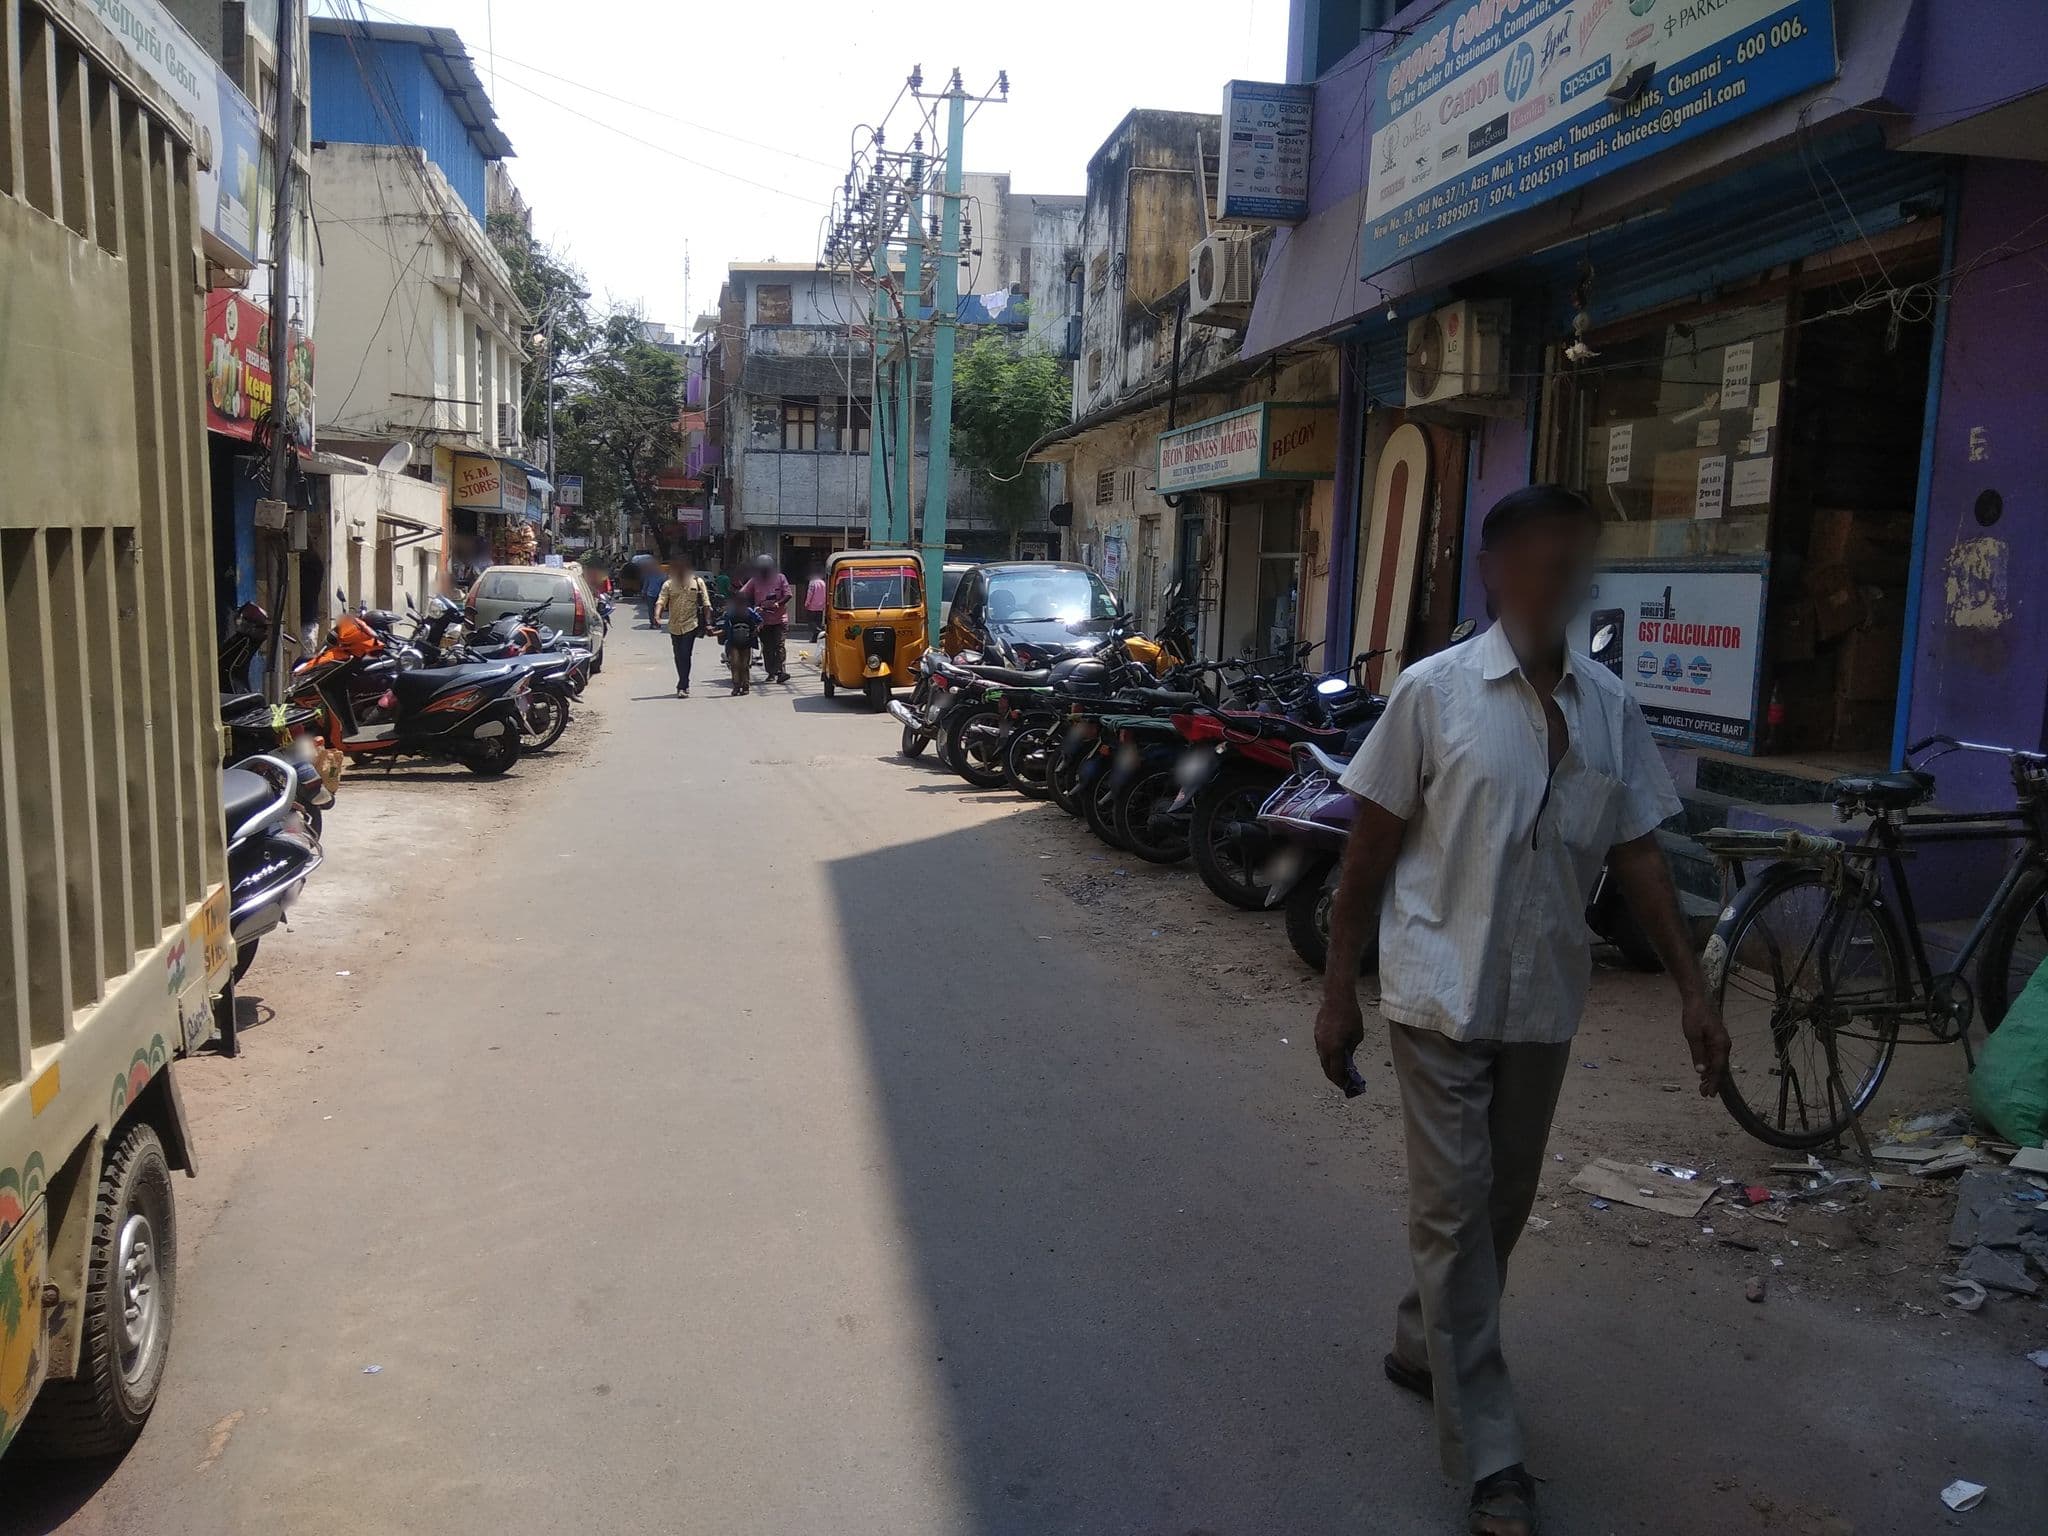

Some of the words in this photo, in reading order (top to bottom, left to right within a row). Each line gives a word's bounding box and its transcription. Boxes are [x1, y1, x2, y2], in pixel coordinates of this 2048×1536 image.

[1387, 24, 1449, 100] CHOICE
[1389, 98, 1403, 116] We
[1403, 88, 1416, 105] Are
[1418, 71, 1443, 97] Dealer
[1444, 62, 1454, 80] Of
[1455, 38, 1501, 71] Stationary,
[1504, 0, 1551, 38] Computer,
[1505, 43, 1534, 102] hp
[1439, 68, 1499, 125] Canon
[1564, 62, 1606, 97] apsara
[1373, 224, 1389, 241] New
[1390, 217, 1402, 232] No.
[1417, 201, 1430, 217] Old
[1470, 173, 1489, 191] Aziz
[1491, 161, 1514, 185] Mulk
[1518, 153, 1531, 170] 1st
[1534, 135, 1566, 163] Street,
[1667, 55, 1721, 97] Chennai
[1737, 33, 1766, 65] 600
[1770, 17, 1808, 49] 006.
[1415, 223, 1430, 241] 044
[1437, 198, 1479, 229] 28295073
[1489, 184, 1516, 207] 5074,
[1519, 159, 1569, 194] 42045191
[1573, 144, 1608, 169] Email:
[1612, 78, 1746, 153] choicecs@gmail.com
[1162, 444, 1184, 468] RECON
[1185, 438, 1218, 463] BUSINESS
[1221, 428, 1258, 455] MACHINES
[1272, 422, 1317, 461] RECON
[458, 477, 500, 498] STORES
[463, 467, 492, 482] K.M.
[1639, 621, 1661, 643] GST
[1662, 622, 1741, 649] CALCULATOR
[1662, 715, 1694, 729] NOVELTY
[1694, 720, 1721, 734] OFFICE
[1721, 724, 1745, 736] MART
